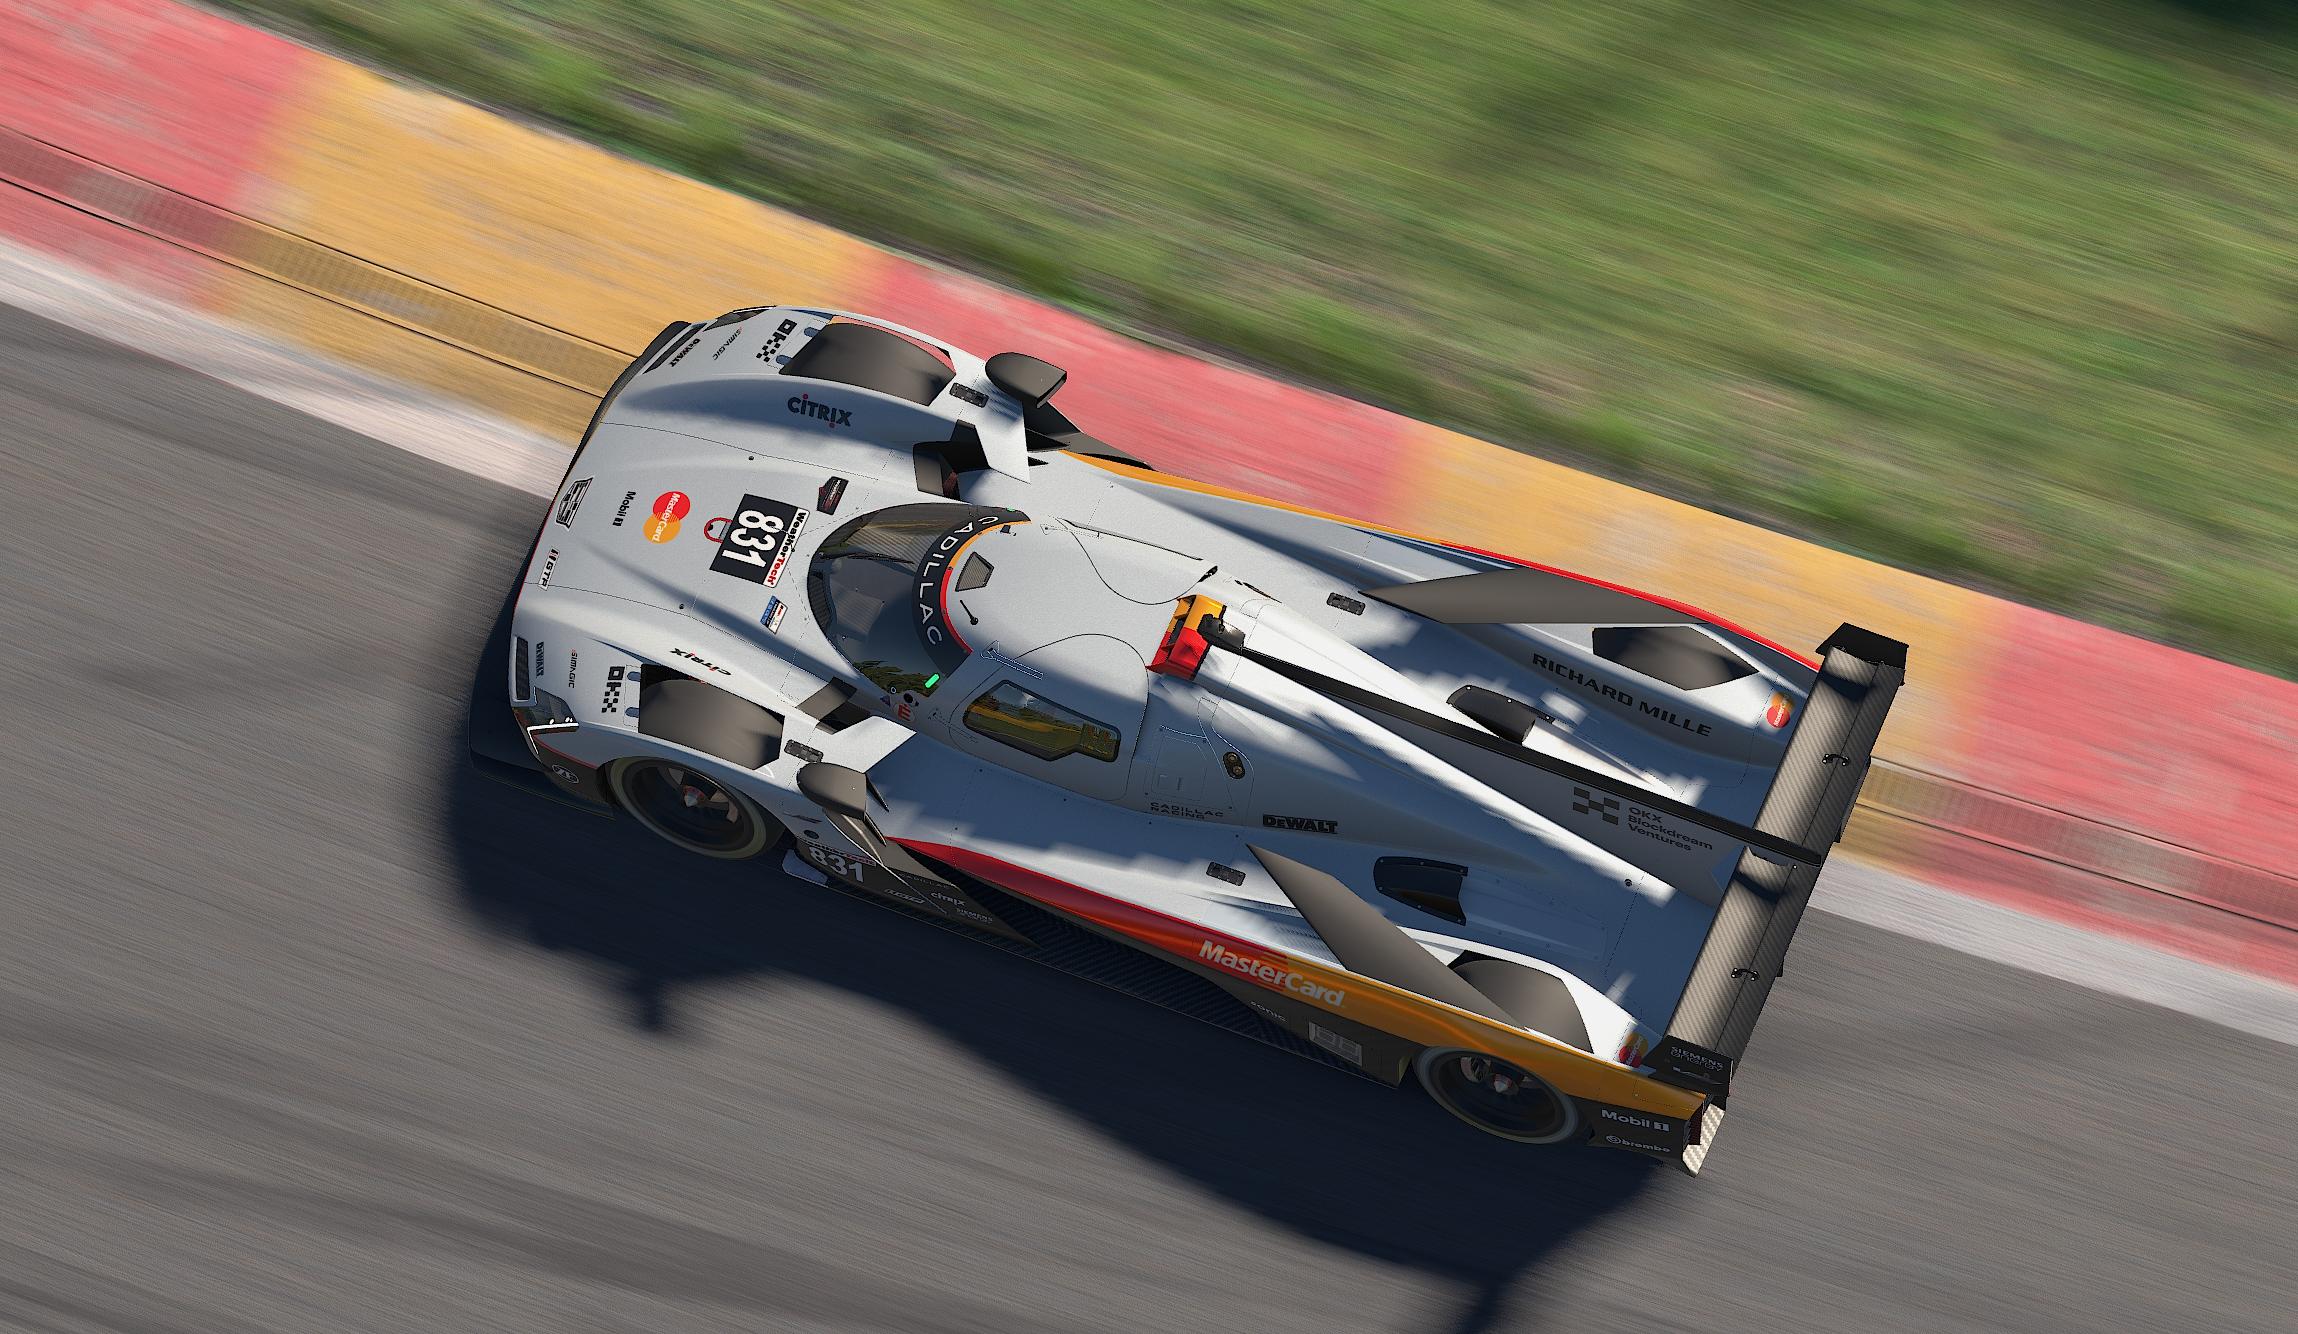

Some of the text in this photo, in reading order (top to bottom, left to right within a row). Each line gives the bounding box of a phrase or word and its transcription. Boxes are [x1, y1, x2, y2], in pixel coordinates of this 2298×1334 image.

[617, 491, 637, 517] Mobil
[652, 493, 680, 542] MasterCard
[722, 510, 784, 568] 831
[767, 512, 807, 586] WeatherTech
[541, 562, 554, 588] GTP
[919, 516, 999, 645] CADILLAC
[1532, 653, 1713, 737] RICHARD MILLE
[1150, 801, 1224, 818] CADILLAC
[1628, 806, 1663, 823] OKX
[1628, 814, 1714, 851] Blockdream
[1628, 823, 1692, 851] Ventures
[809, 846, 865, 883] 831
[1199, 940, 1346, 1007] MasterCard
[1671, 1046, 1724, 1068] SIEMENS
[1601, 1109, 1650, 1128] Mobil
[1622, 1139, 1671, 1153] brembo
